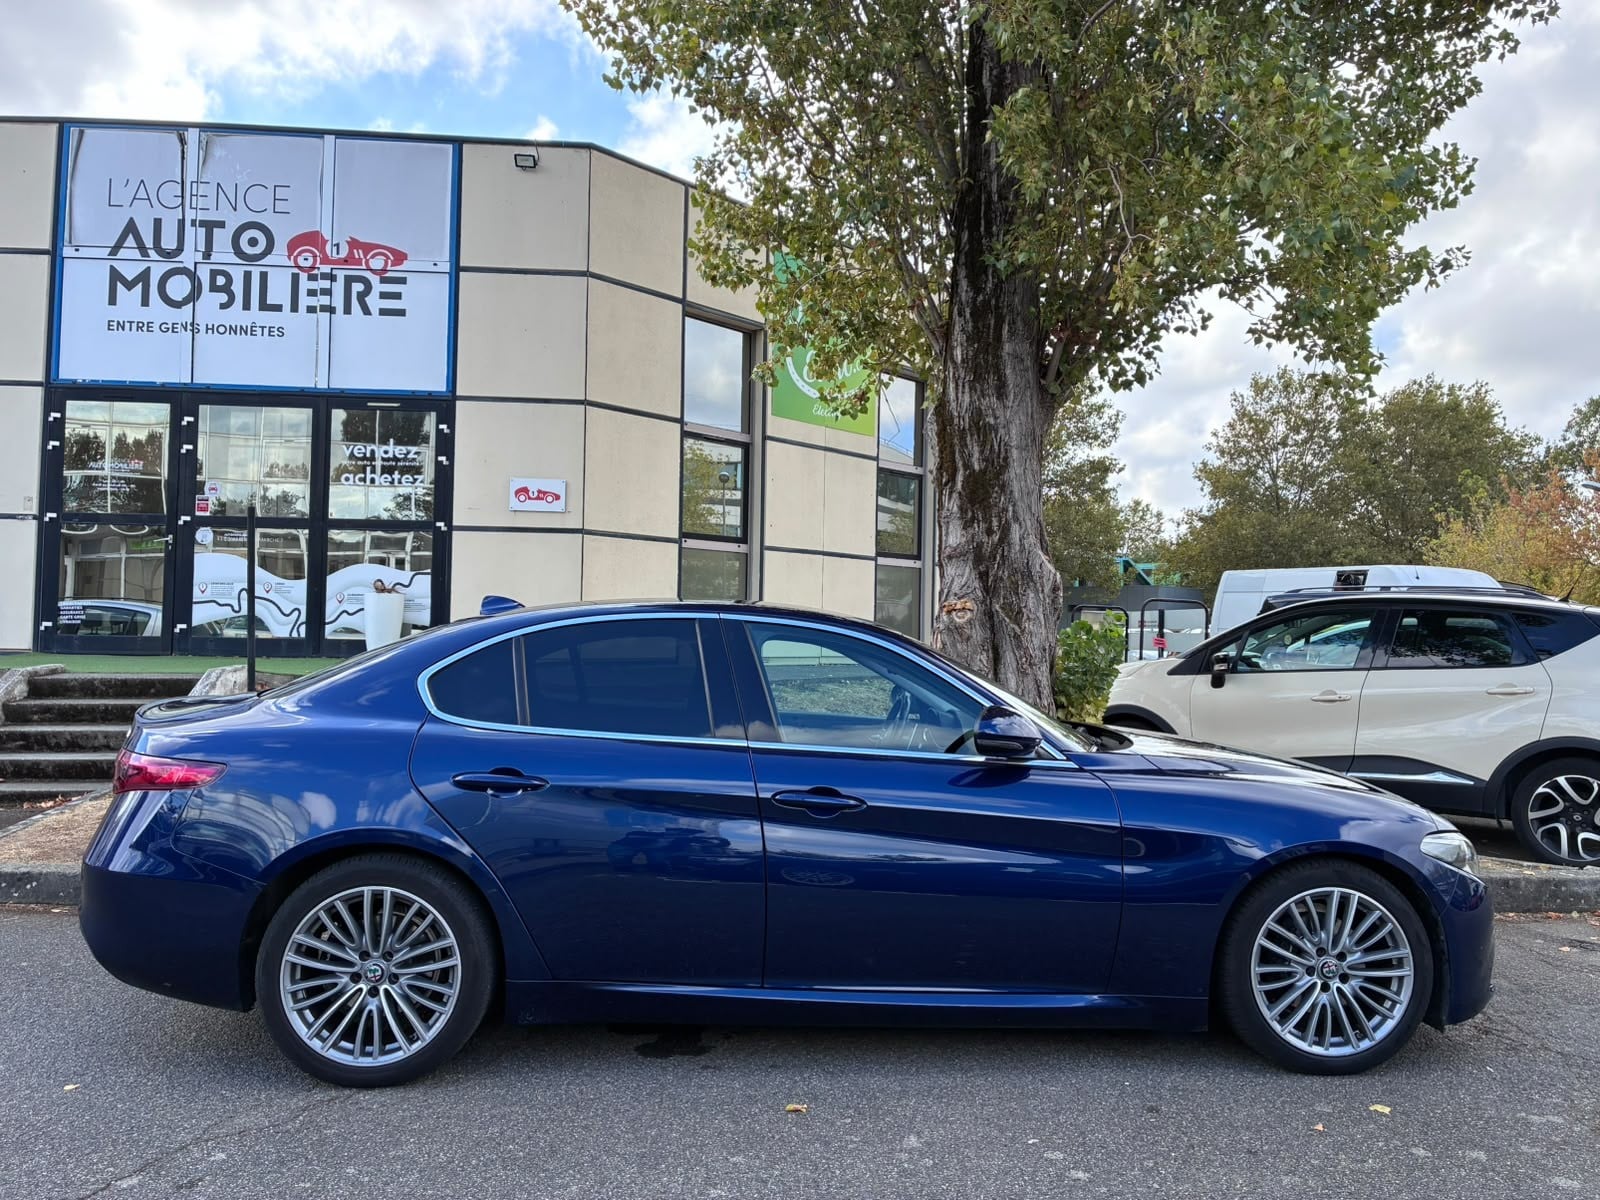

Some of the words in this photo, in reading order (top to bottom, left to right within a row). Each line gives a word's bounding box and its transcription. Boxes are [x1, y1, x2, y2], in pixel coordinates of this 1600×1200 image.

[107, 177, 291, 215] L'AGENCE
[107, 217, 276, 263] AUTO
[333, 242, 340, 256] 1
[107, 319, 154, 333] ENTRE
[159, 321, 200, 334] GENS
[205, 322, 285, 337] HONNÊTES
[342, 438, 418, 459] vendez
[340, 466, 425, 486] achetez
